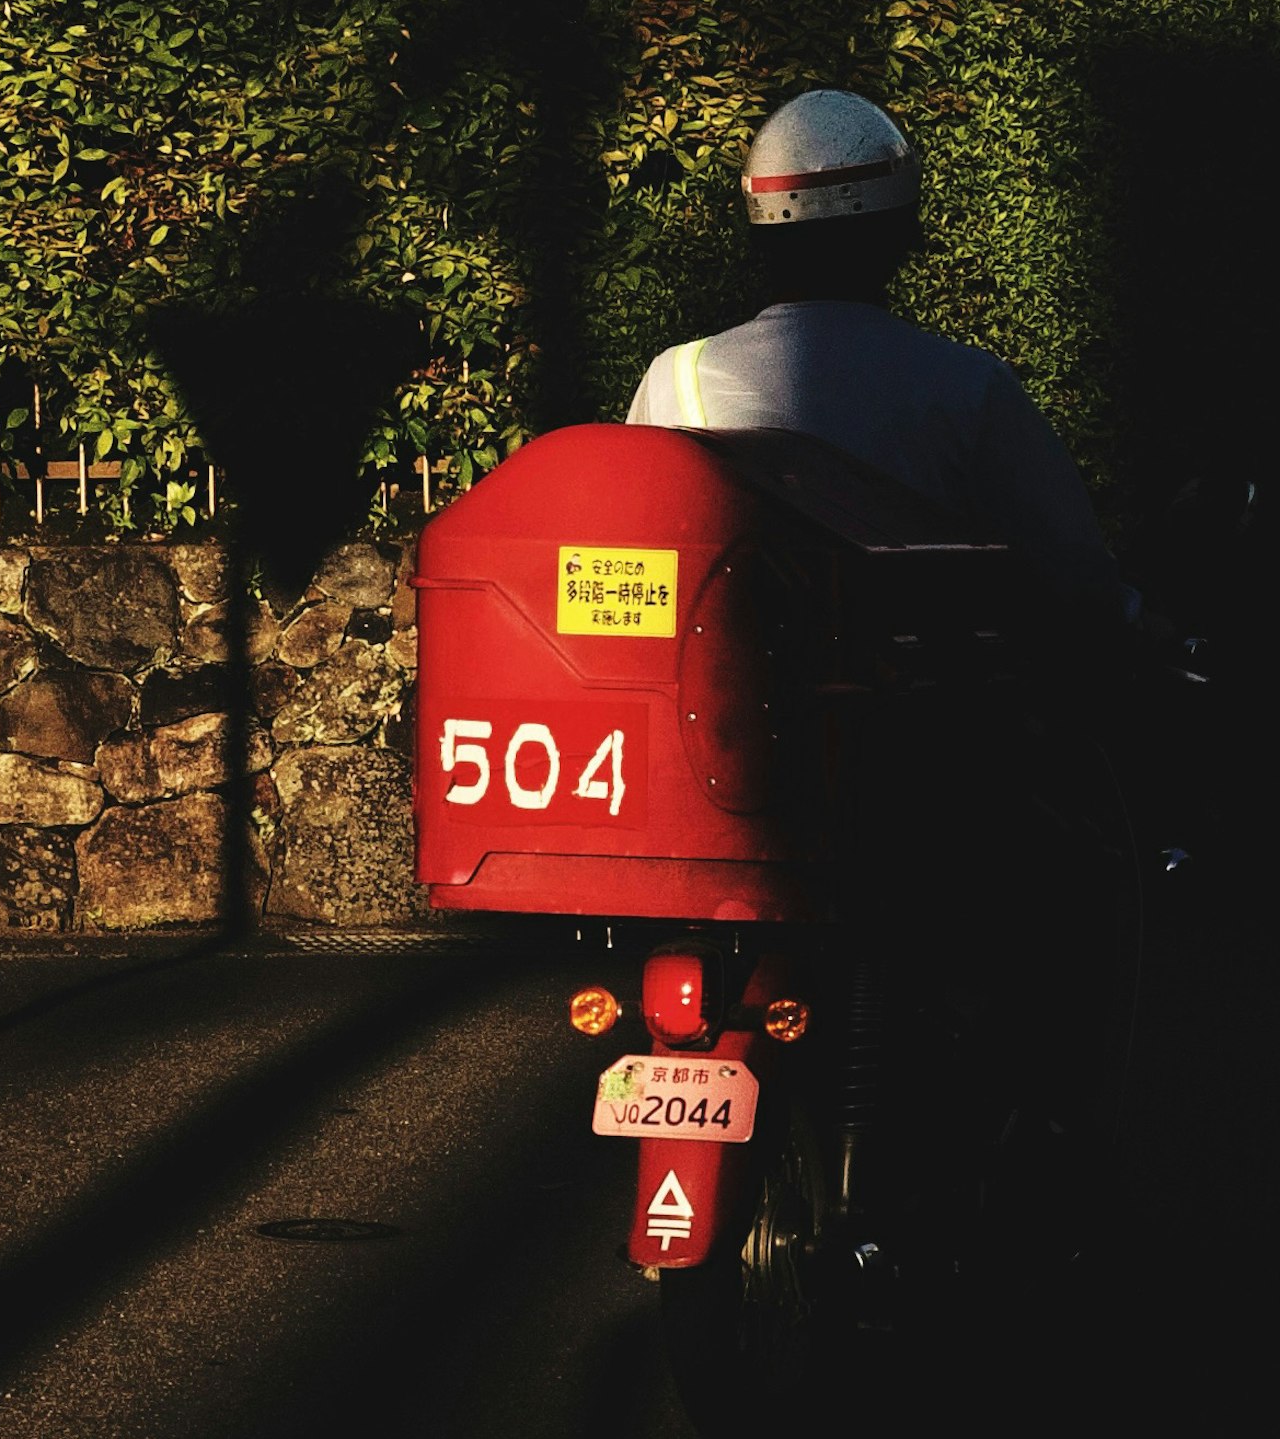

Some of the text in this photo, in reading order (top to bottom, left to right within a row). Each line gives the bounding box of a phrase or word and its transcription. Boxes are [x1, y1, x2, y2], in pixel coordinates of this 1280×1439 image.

[592, 559, 645, 576] 安全のため
[566, 580, 670, 607] 多段階一時停止を
[439, 718, 626, 816] 504
[650, 1066, 710, 1085] 京都市
